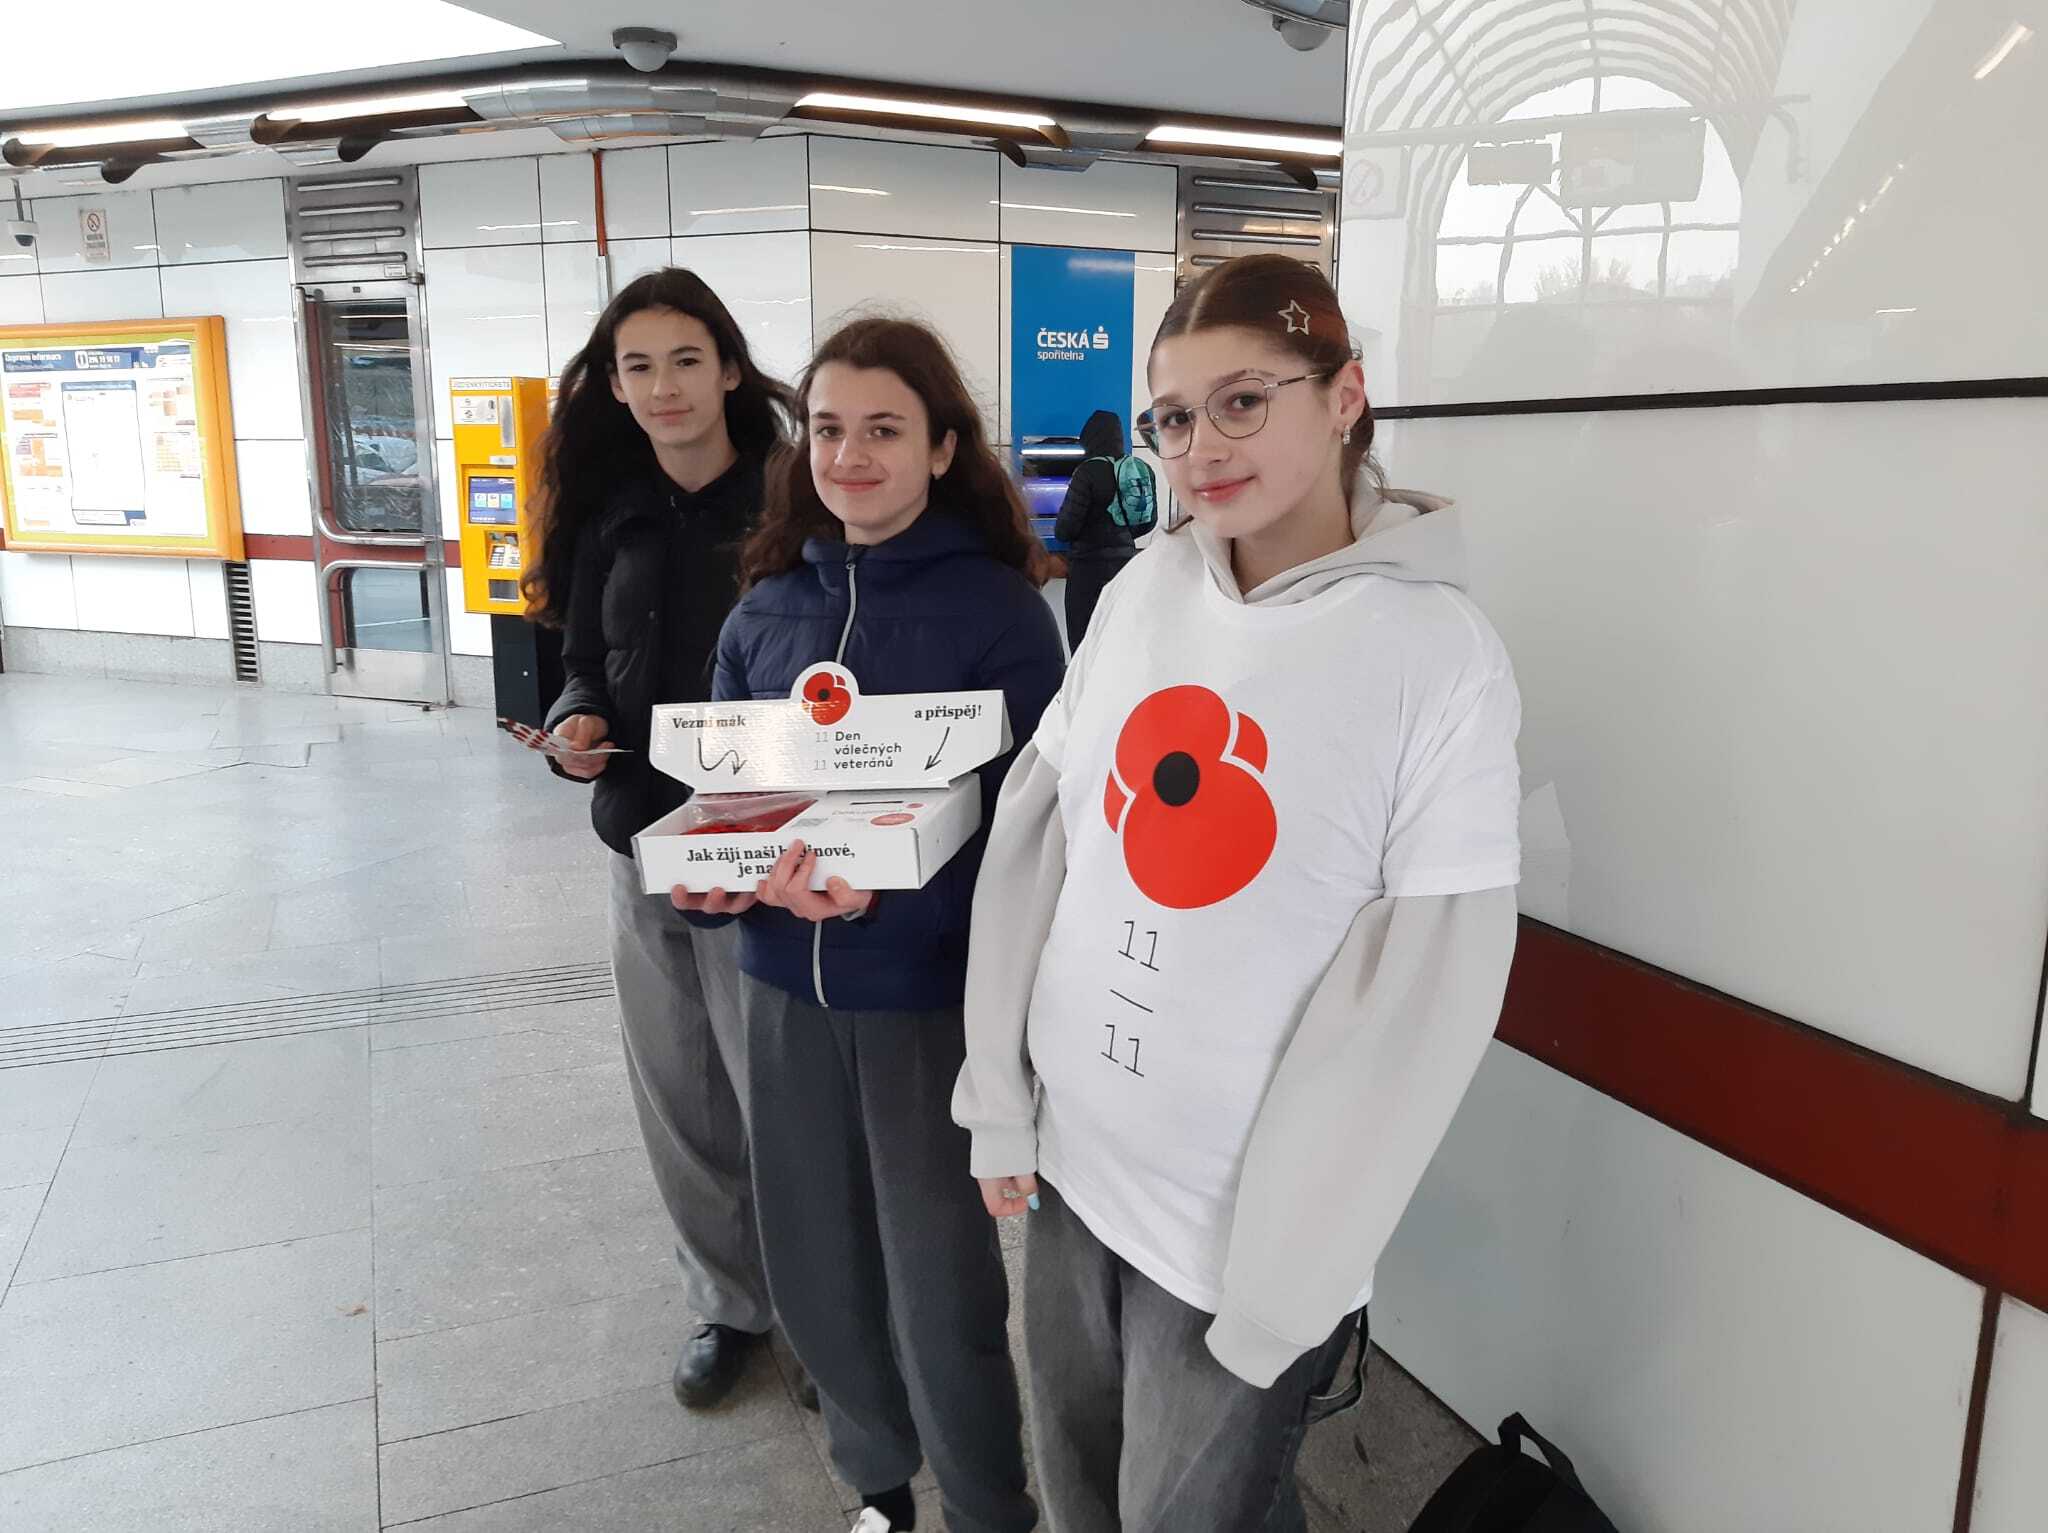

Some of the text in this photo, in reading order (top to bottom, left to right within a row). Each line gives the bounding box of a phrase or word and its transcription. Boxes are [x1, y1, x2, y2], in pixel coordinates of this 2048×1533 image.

[1037, 328, 1089, 348] ČESKÁ
[1037, 350, 1084, 361] spořitelna
[914, 704, 982, 721] a přispěj!
[672, 714, 746, 729] Vezmi mák
[835, 731, 861, 742] Den
[834, 743, 902, 757] válečných
[834, 756, 894, 769] veteránů
[687, 848, 714, 862] Jak
[716, 847, 741, 863] žijí
[743, 846, 776, 860] naši
[737, 862, 752, 878] je
[1118, 920, 1160, 972] 11
[1100, 1023, 1145, 1078] 11
